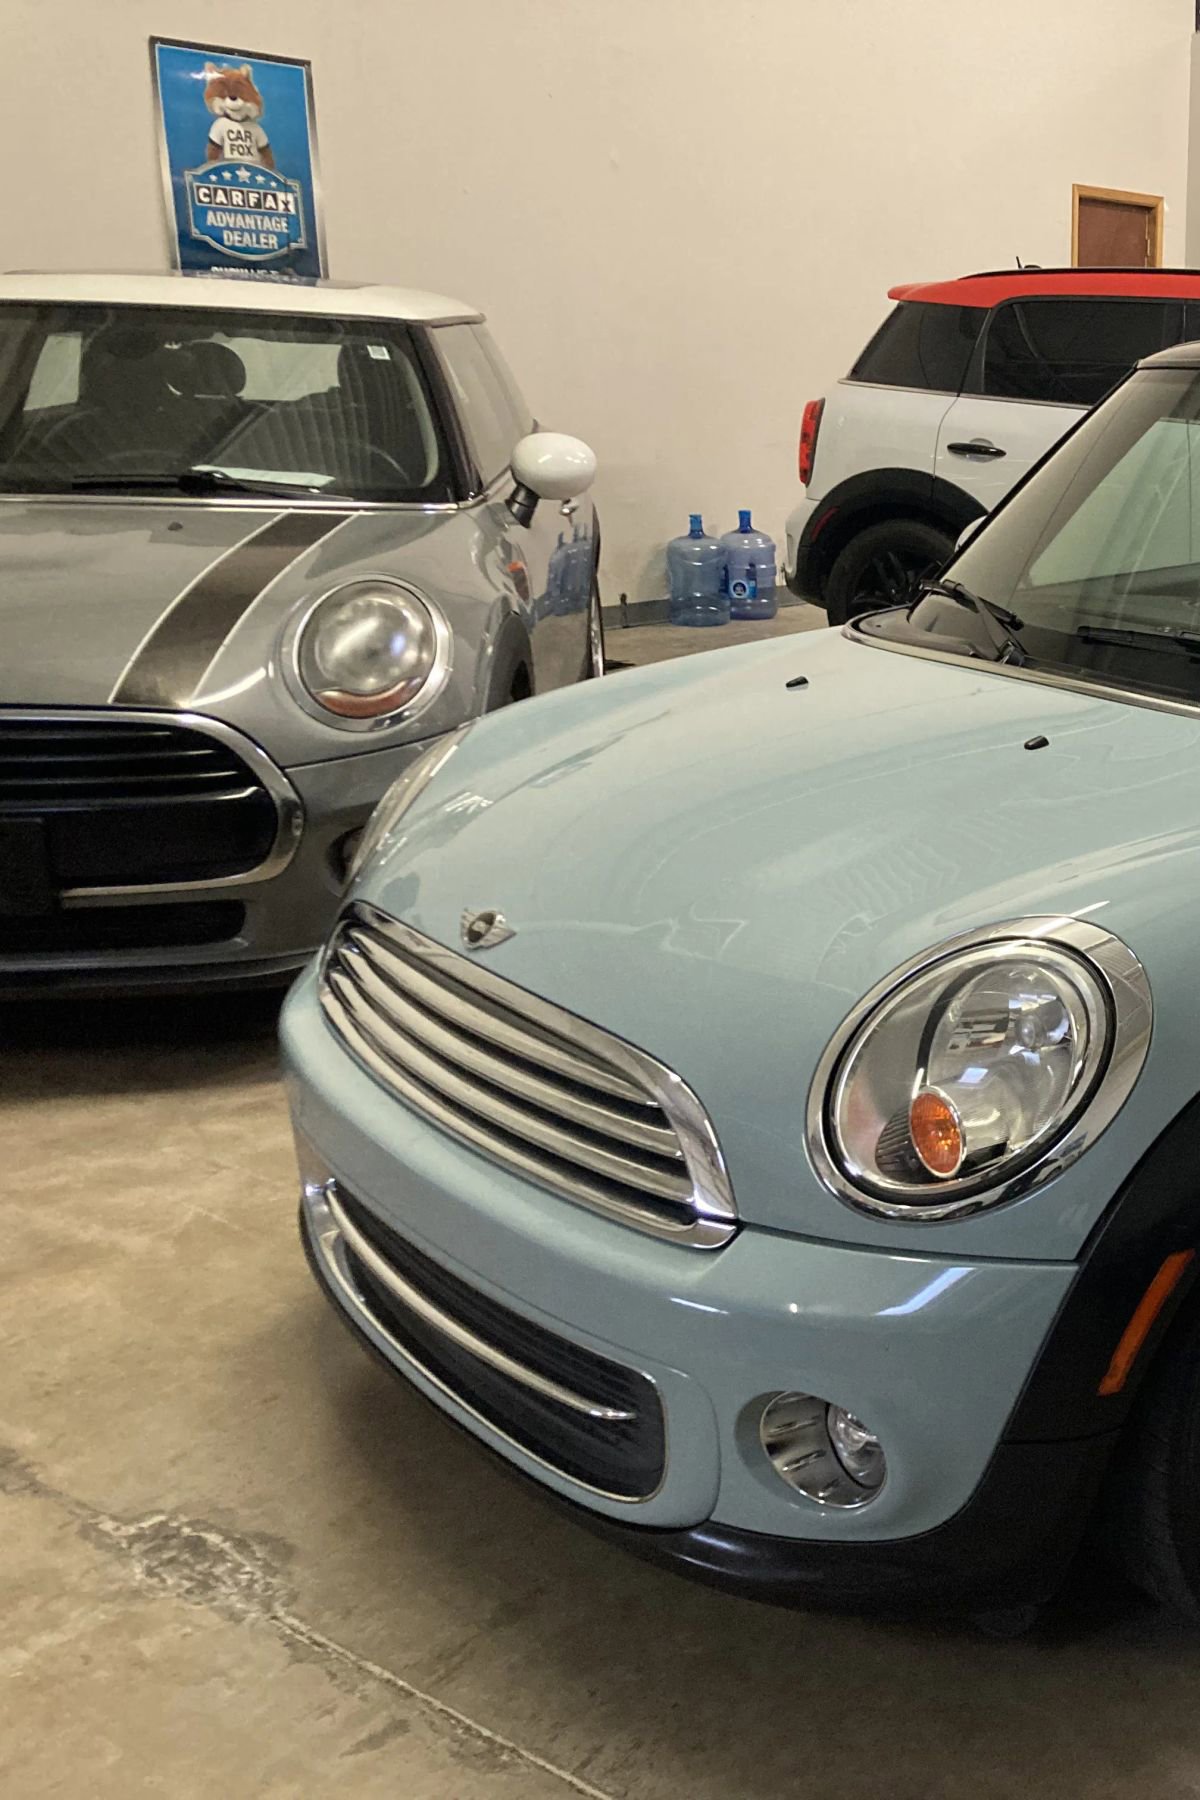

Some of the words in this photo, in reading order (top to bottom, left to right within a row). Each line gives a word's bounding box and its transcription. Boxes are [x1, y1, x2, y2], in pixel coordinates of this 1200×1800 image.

[227, 129, 253, 143] CAR
[230, 143, 254, 157] FOX
[198, 187, 295, 214] CARFAX
[207, 210, 289, 232] ADVANTAGE
[223, 230, 279, 249] DEALER
